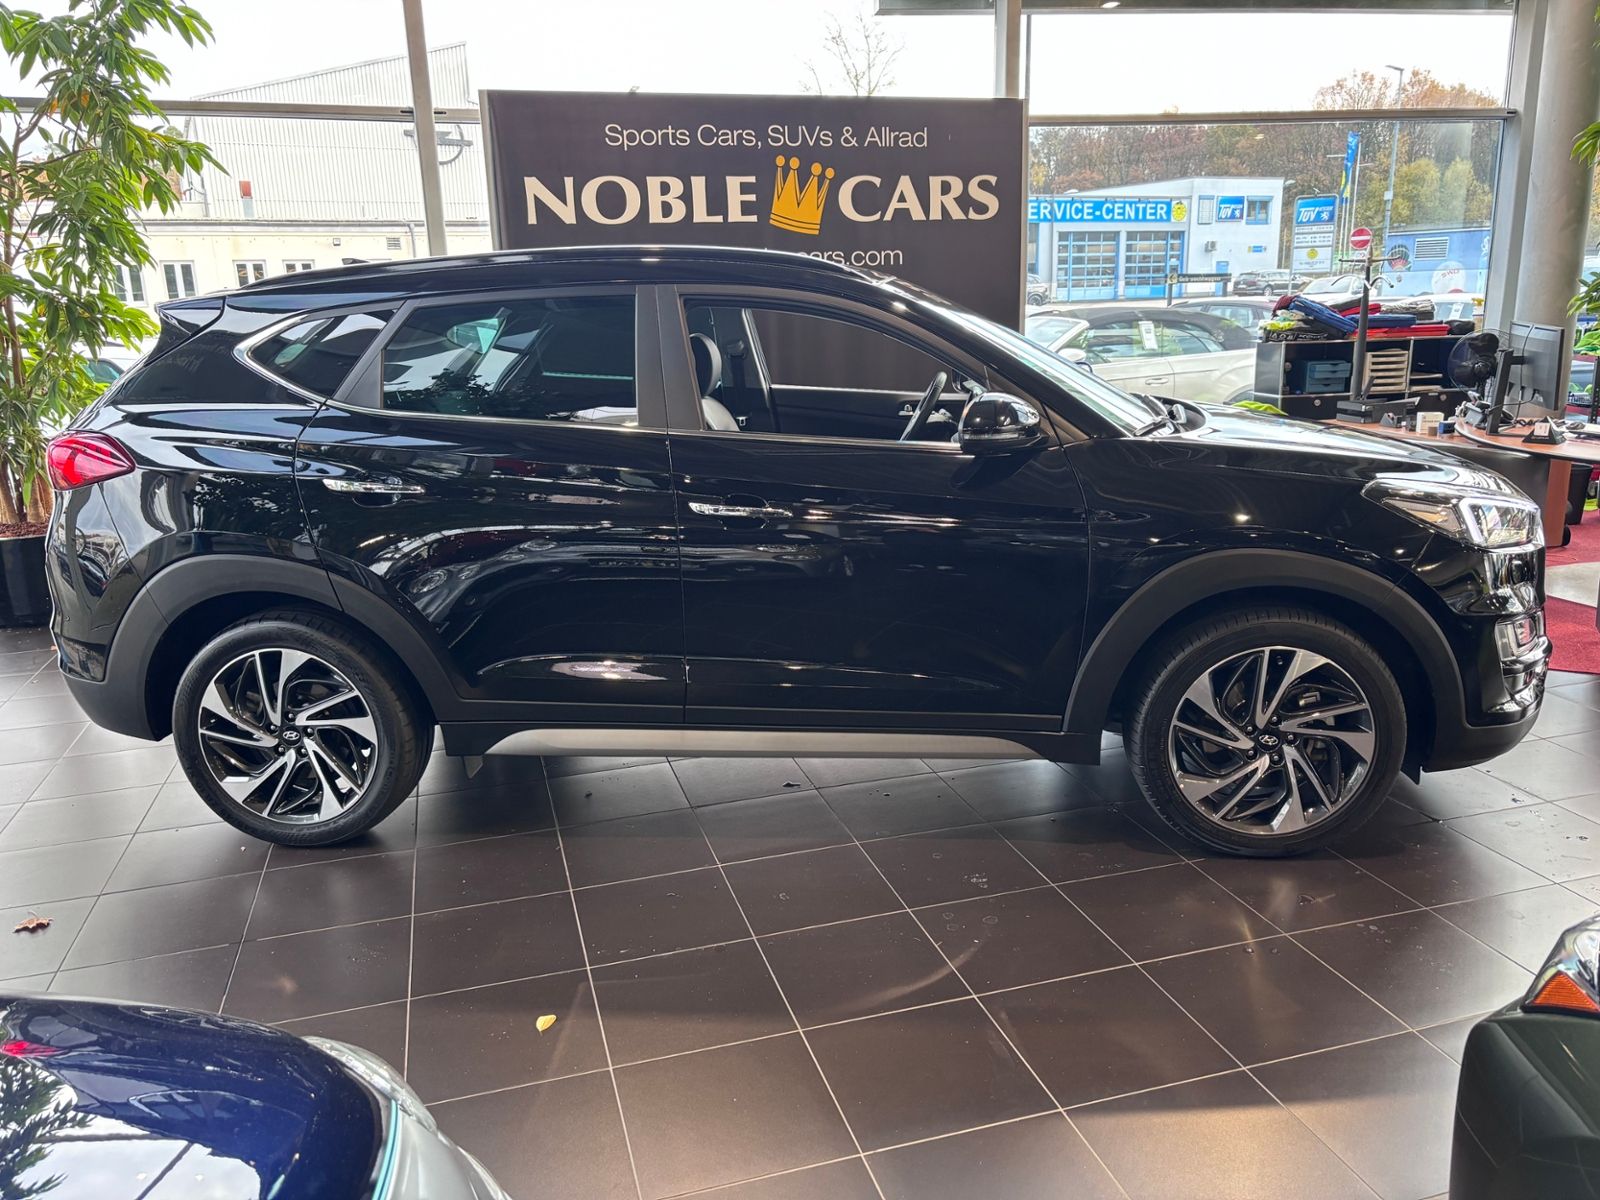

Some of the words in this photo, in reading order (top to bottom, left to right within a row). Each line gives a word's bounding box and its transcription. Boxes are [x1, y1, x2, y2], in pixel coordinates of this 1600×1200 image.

[604, 123, 691, 152] Sports
[697, 123, 762, 150] Cars,
[767, 124, 833, 147] SUVs
[840, 126, 859, 147] &
[863, 126, 928, 148] Allrad
[523, 175, 758, 225] NOBLE
[838, 174, 1000, 223] CARS
